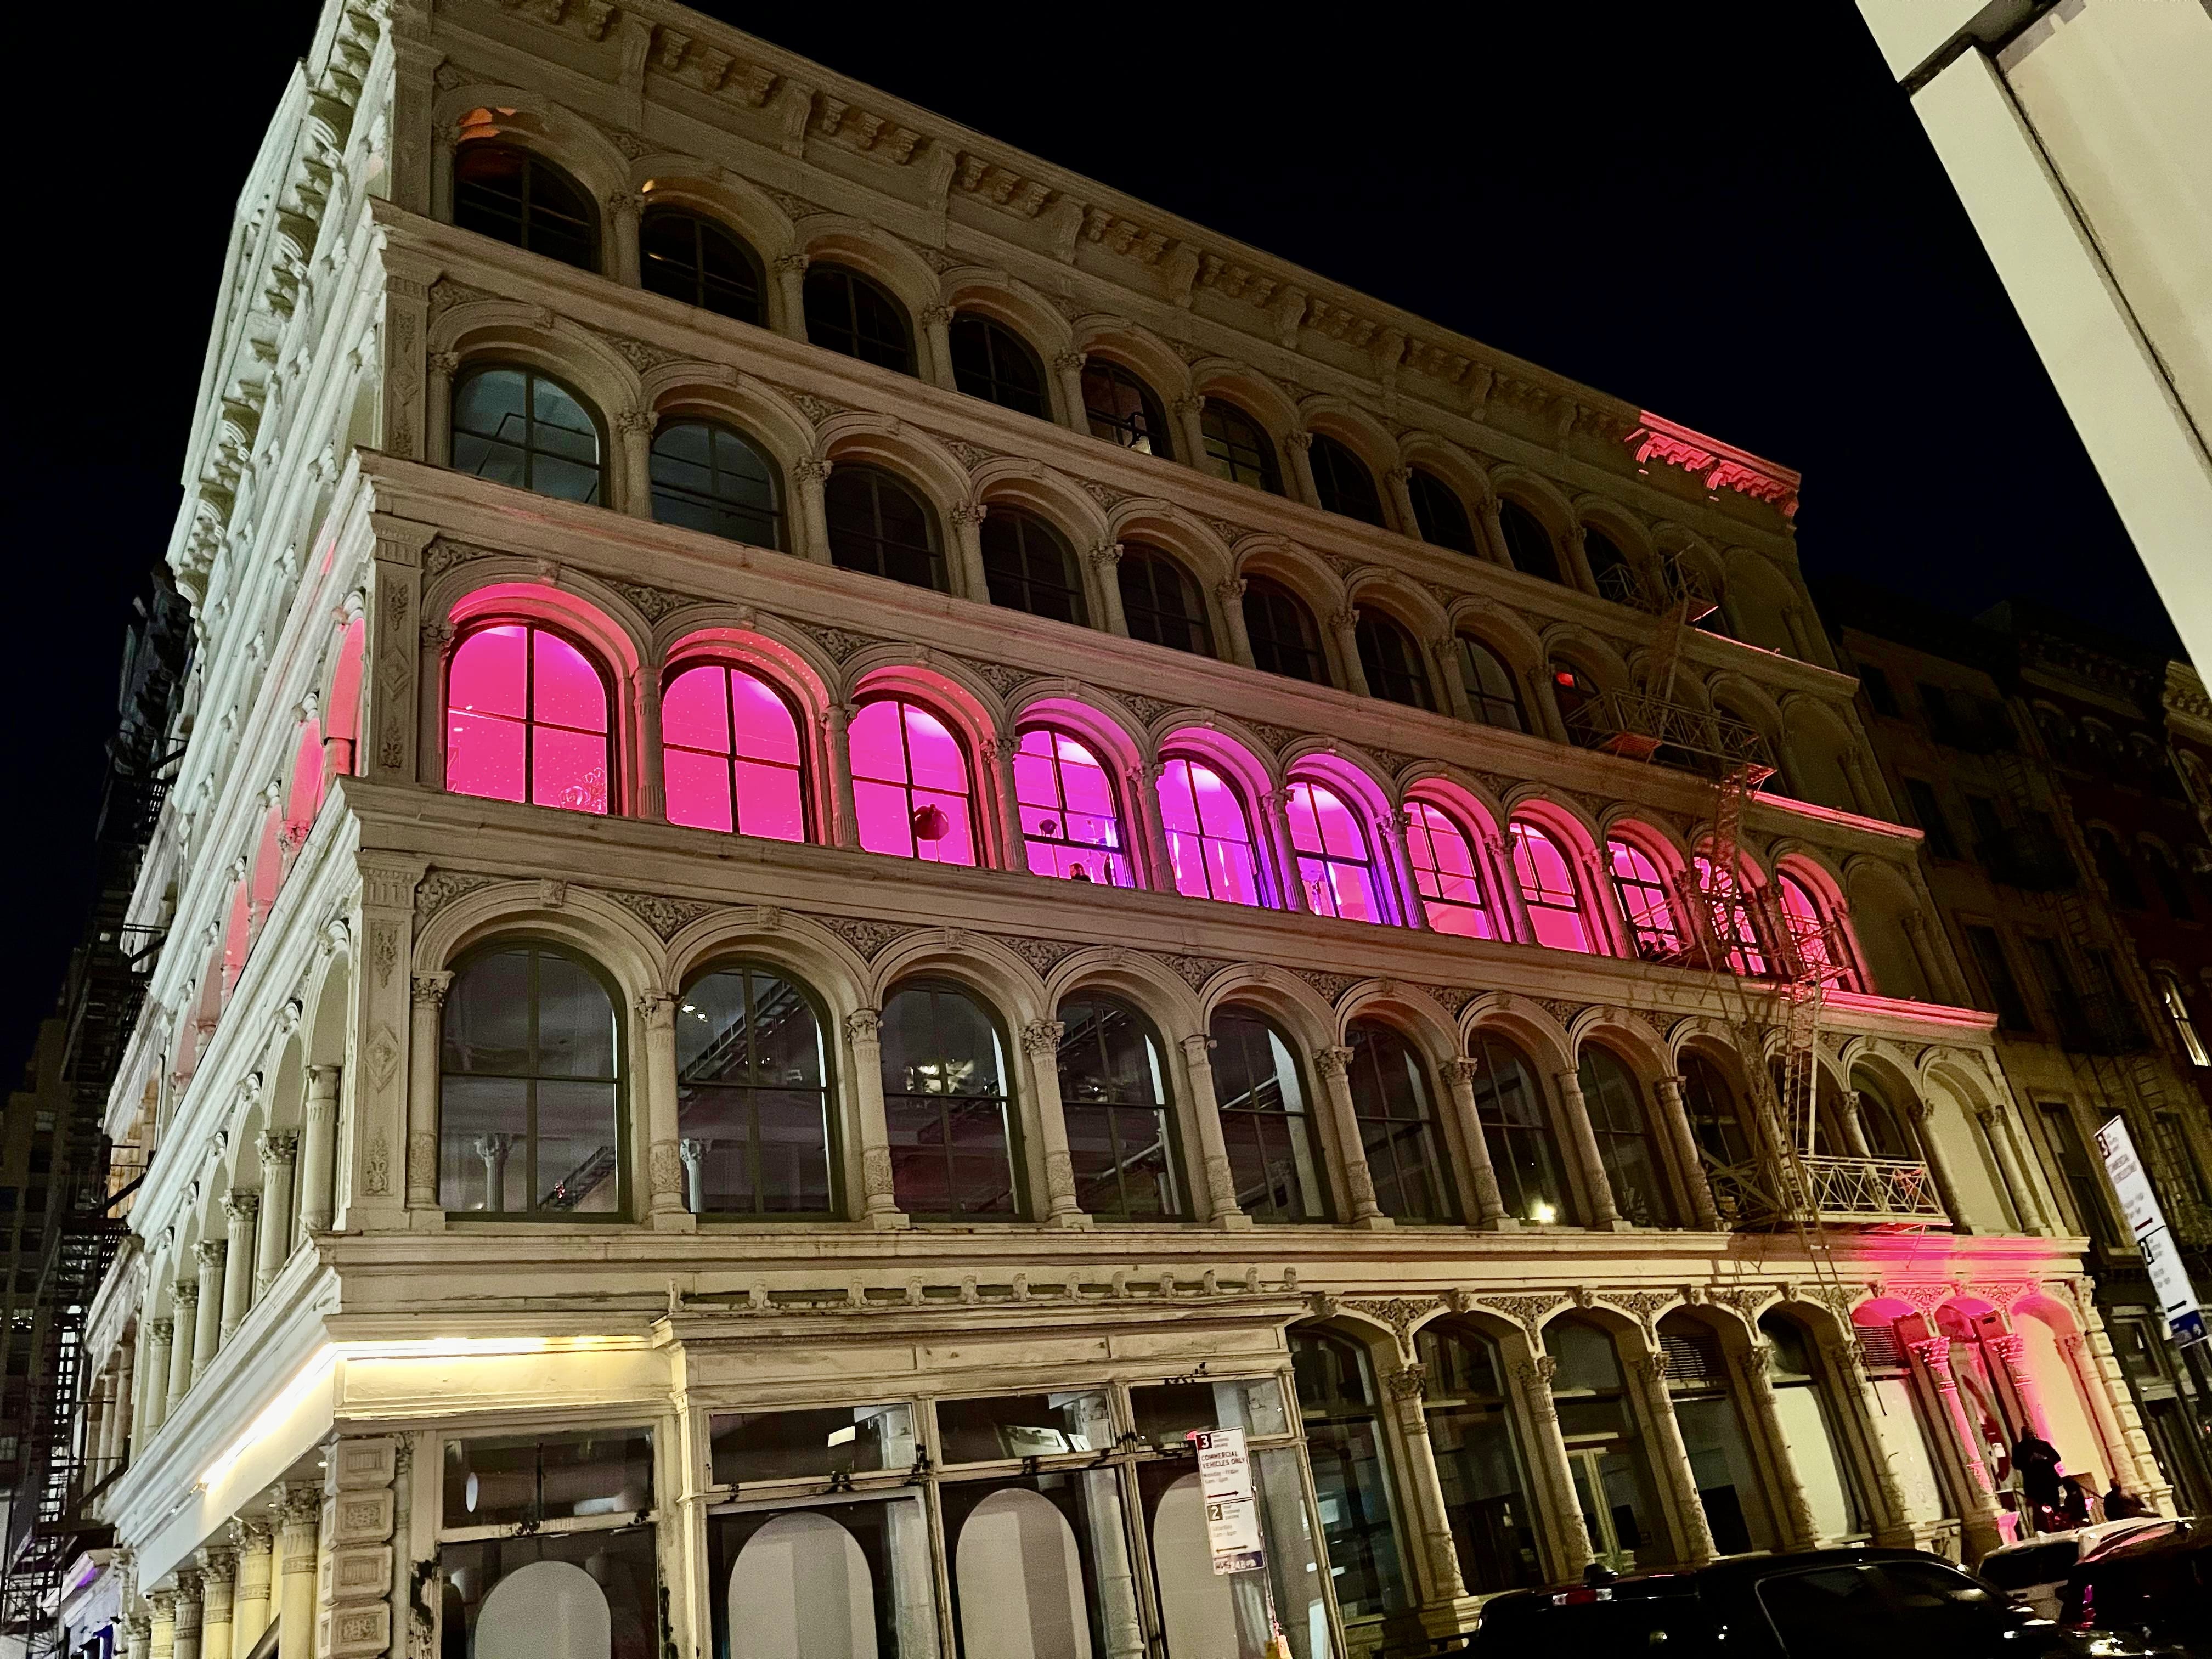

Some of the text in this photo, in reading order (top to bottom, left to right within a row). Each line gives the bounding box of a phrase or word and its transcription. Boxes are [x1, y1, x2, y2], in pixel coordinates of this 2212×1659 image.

[1200, 1435, 1209, 1448] 3
[1201, 1451, 1238, 1462] COMMERCIAL
[1202, 1459, 1230, 1469] VEHICLES
[1211, 1506, 1220, 1520] 2
